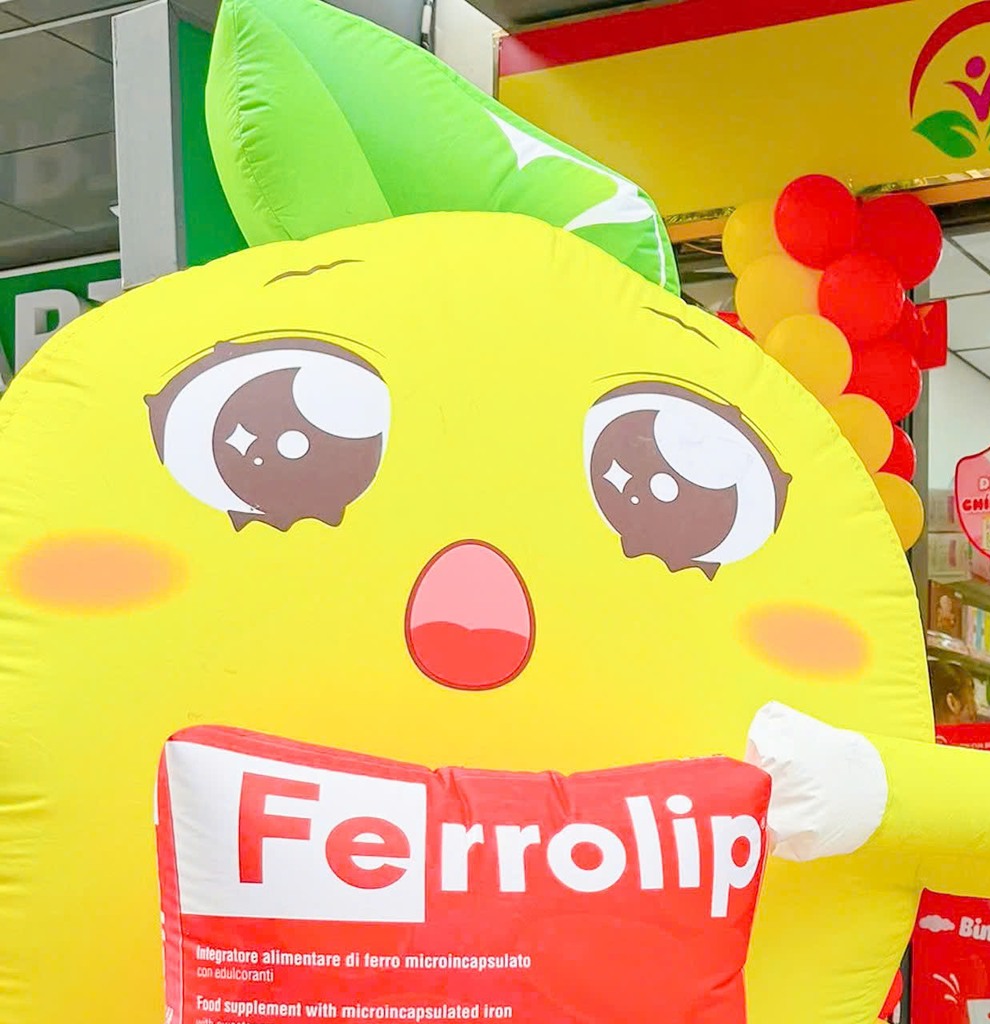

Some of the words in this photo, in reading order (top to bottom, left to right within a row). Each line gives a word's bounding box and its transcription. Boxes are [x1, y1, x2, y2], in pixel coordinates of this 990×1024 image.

[239, 771, 763, 918] Ferrolip
[196, 944, 258, 965] Integratore
[262, 949, 340, 967] alimentare
[345, 952, 360, 967] di
[364, 952, 400, 969] ferro
[404, 953, 532, 972] microincapsulato
[196, 967, 213, 978] con
[214, 966, 274, 983] edulcoranti
[196, 995, 221, 1013] Food
[224, 998, 301, 1017] supplement
[305, 1001, 337, 1017] with
[341, 1002, 479, 1022] microincapsulated
[483, 1003, 513, 1019] iron
